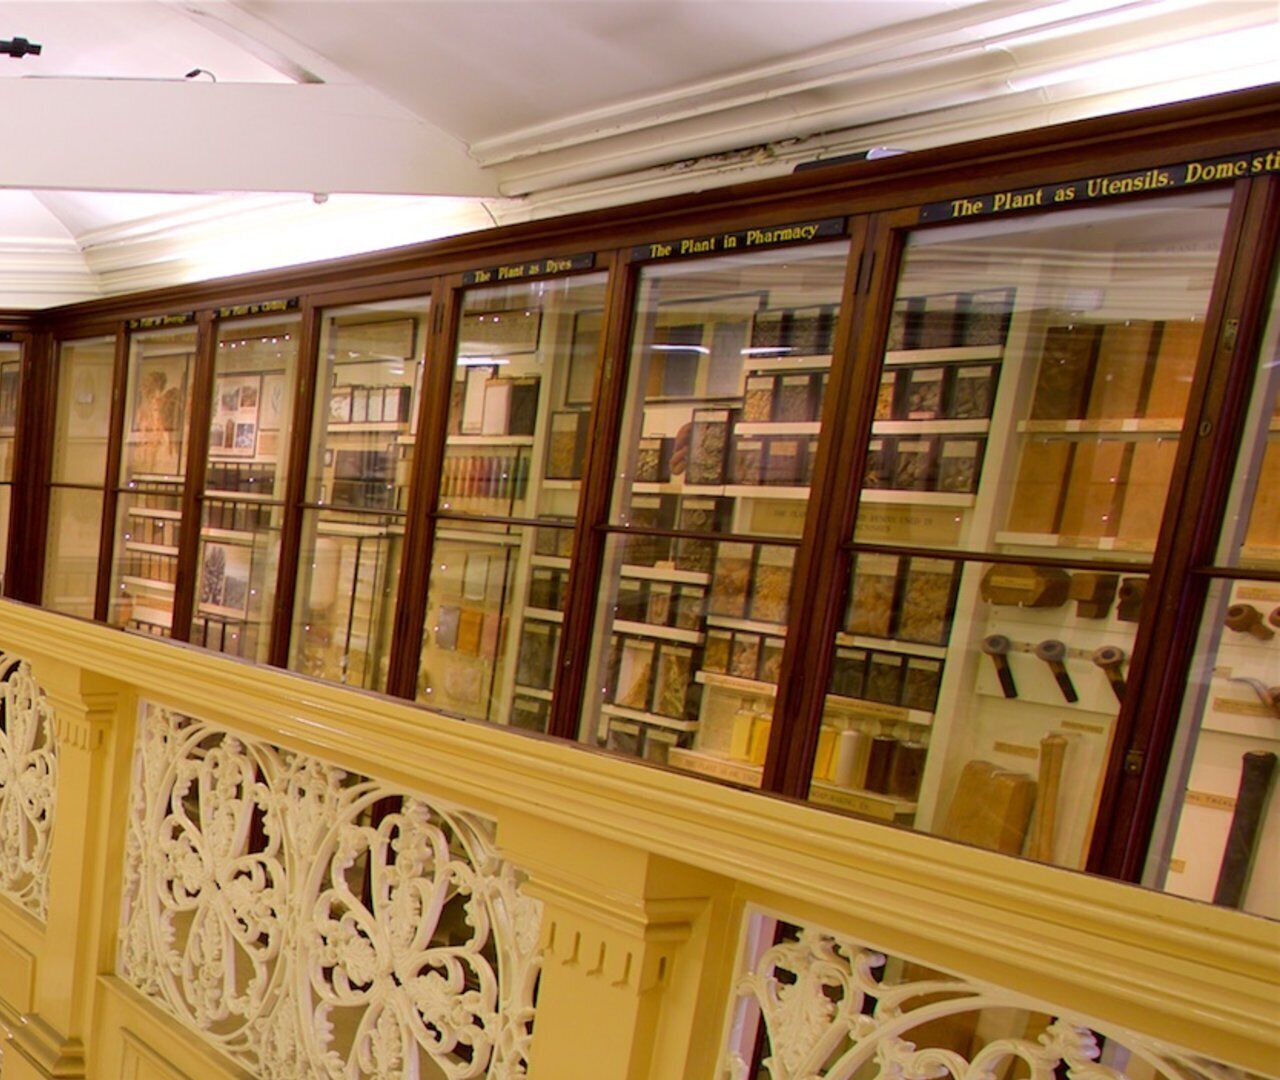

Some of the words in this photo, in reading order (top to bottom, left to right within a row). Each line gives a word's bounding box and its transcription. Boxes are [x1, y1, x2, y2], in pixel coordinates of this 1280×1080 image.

[951, 200, 983, 217] The
[992, 188, 1043, 212] Plant
[1054, 186, 1075, 201] as
[1086, 169, 1175, 197] Utensils.
[650, 243, 671, 257] The
[681, 237, 715, 254] Plant
[724, 234, 736, 248] in
[746, 223, 819, 246] Pharmacy
[474, 270, 491, 283] The
[498, 264, 524, 280] Plant
[528, 264, 540, 275] as
[546, 259, 572, 273] Dyes
